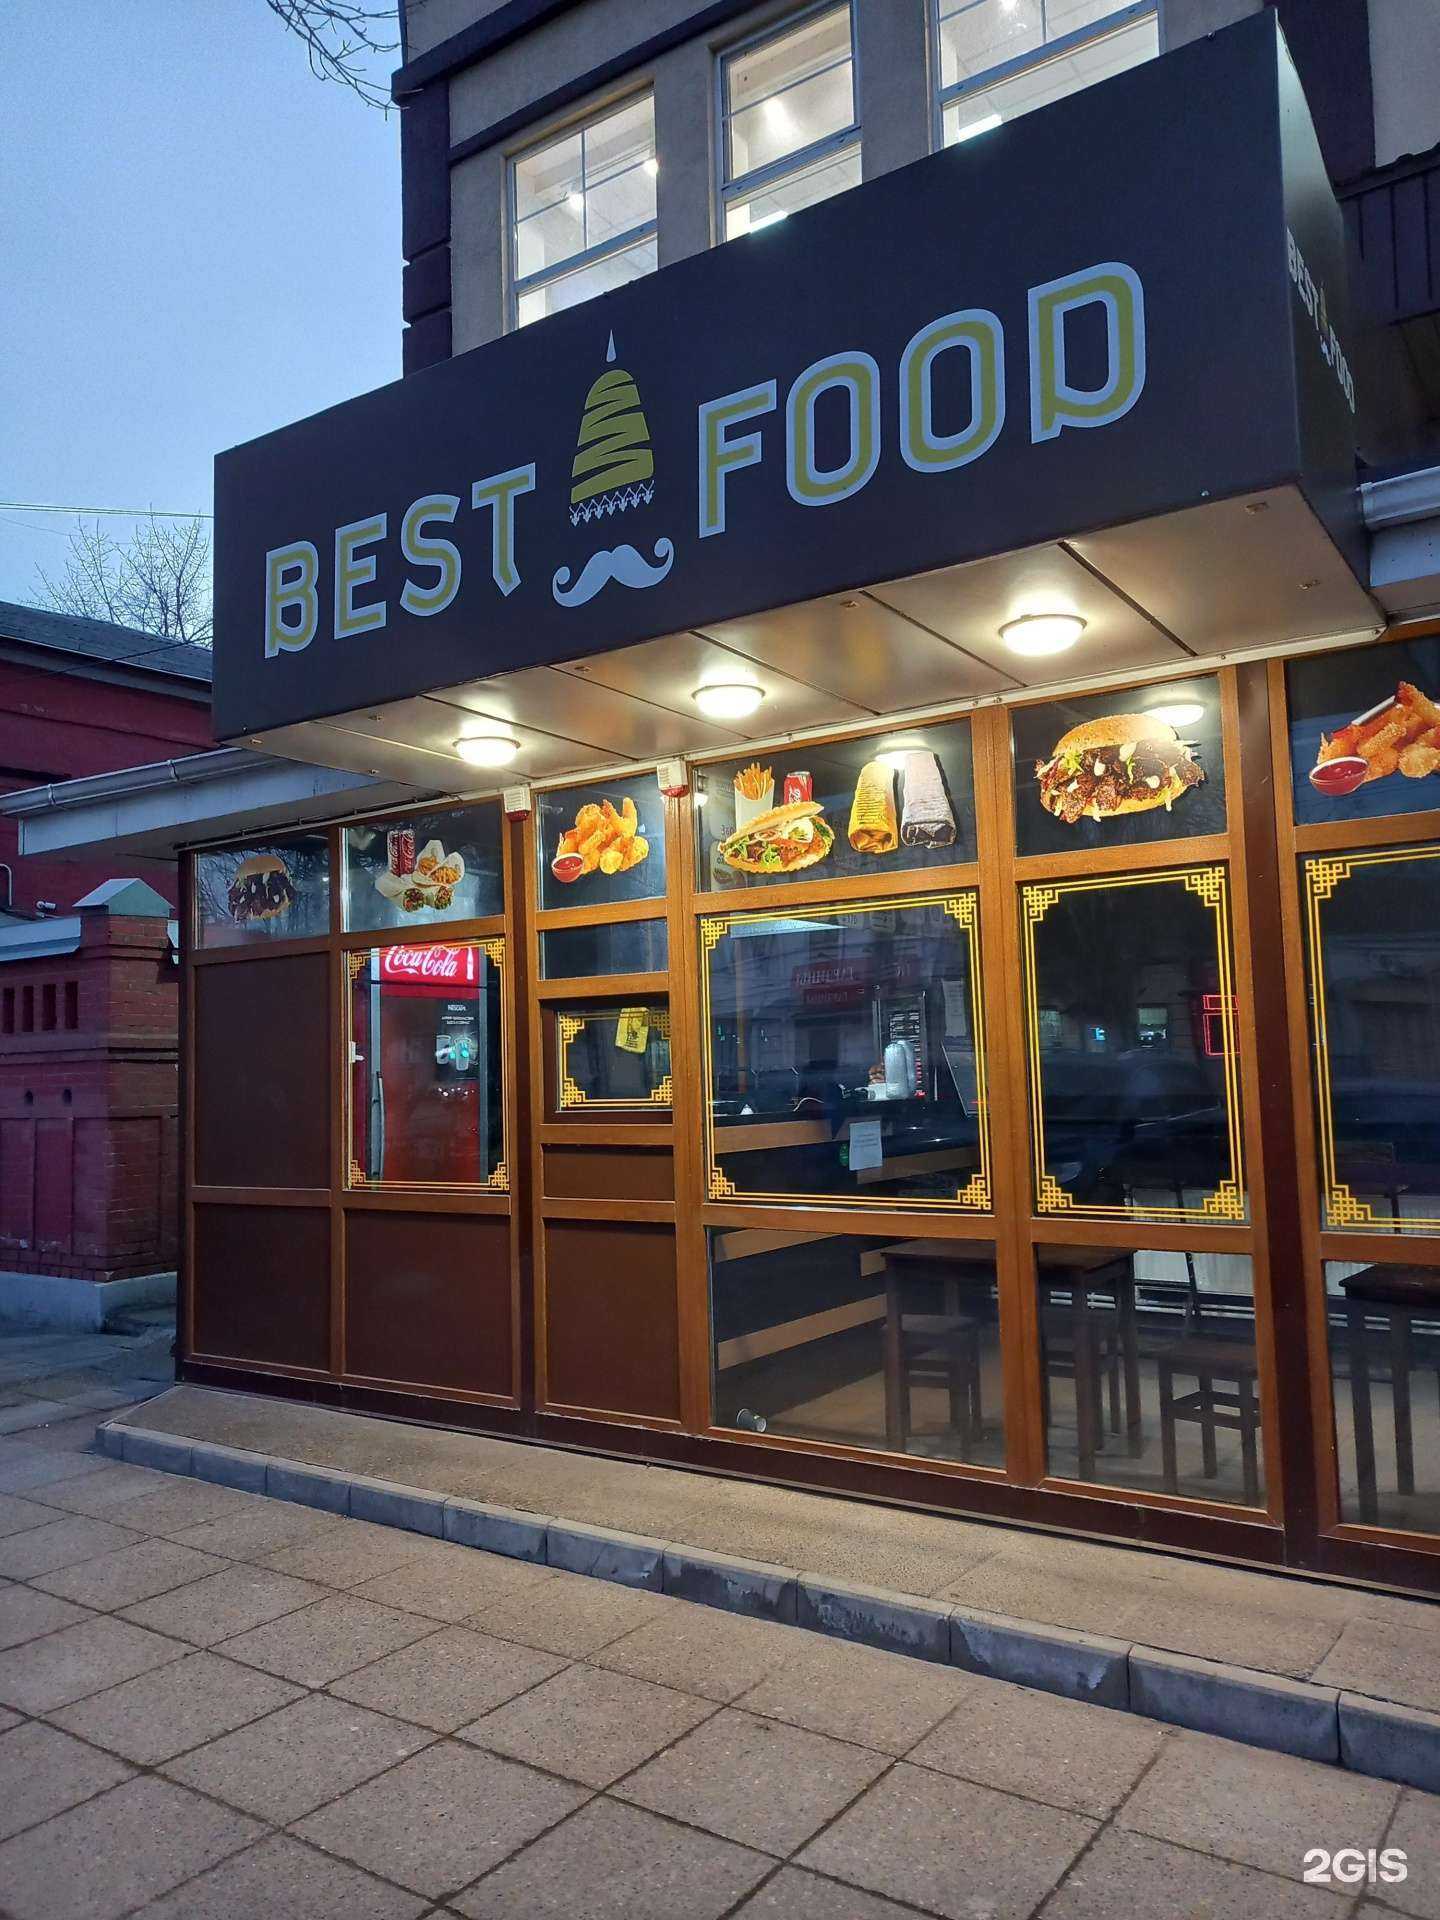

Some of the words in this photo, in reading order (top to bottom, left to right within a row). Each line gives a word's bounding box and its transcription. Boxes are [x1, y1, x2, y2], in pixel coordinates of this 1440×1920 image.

[1287, 226, 1319, 331] BEST
[264, 462, 536, 659] BEST
[699, 261, 1146, 538] FOOD
